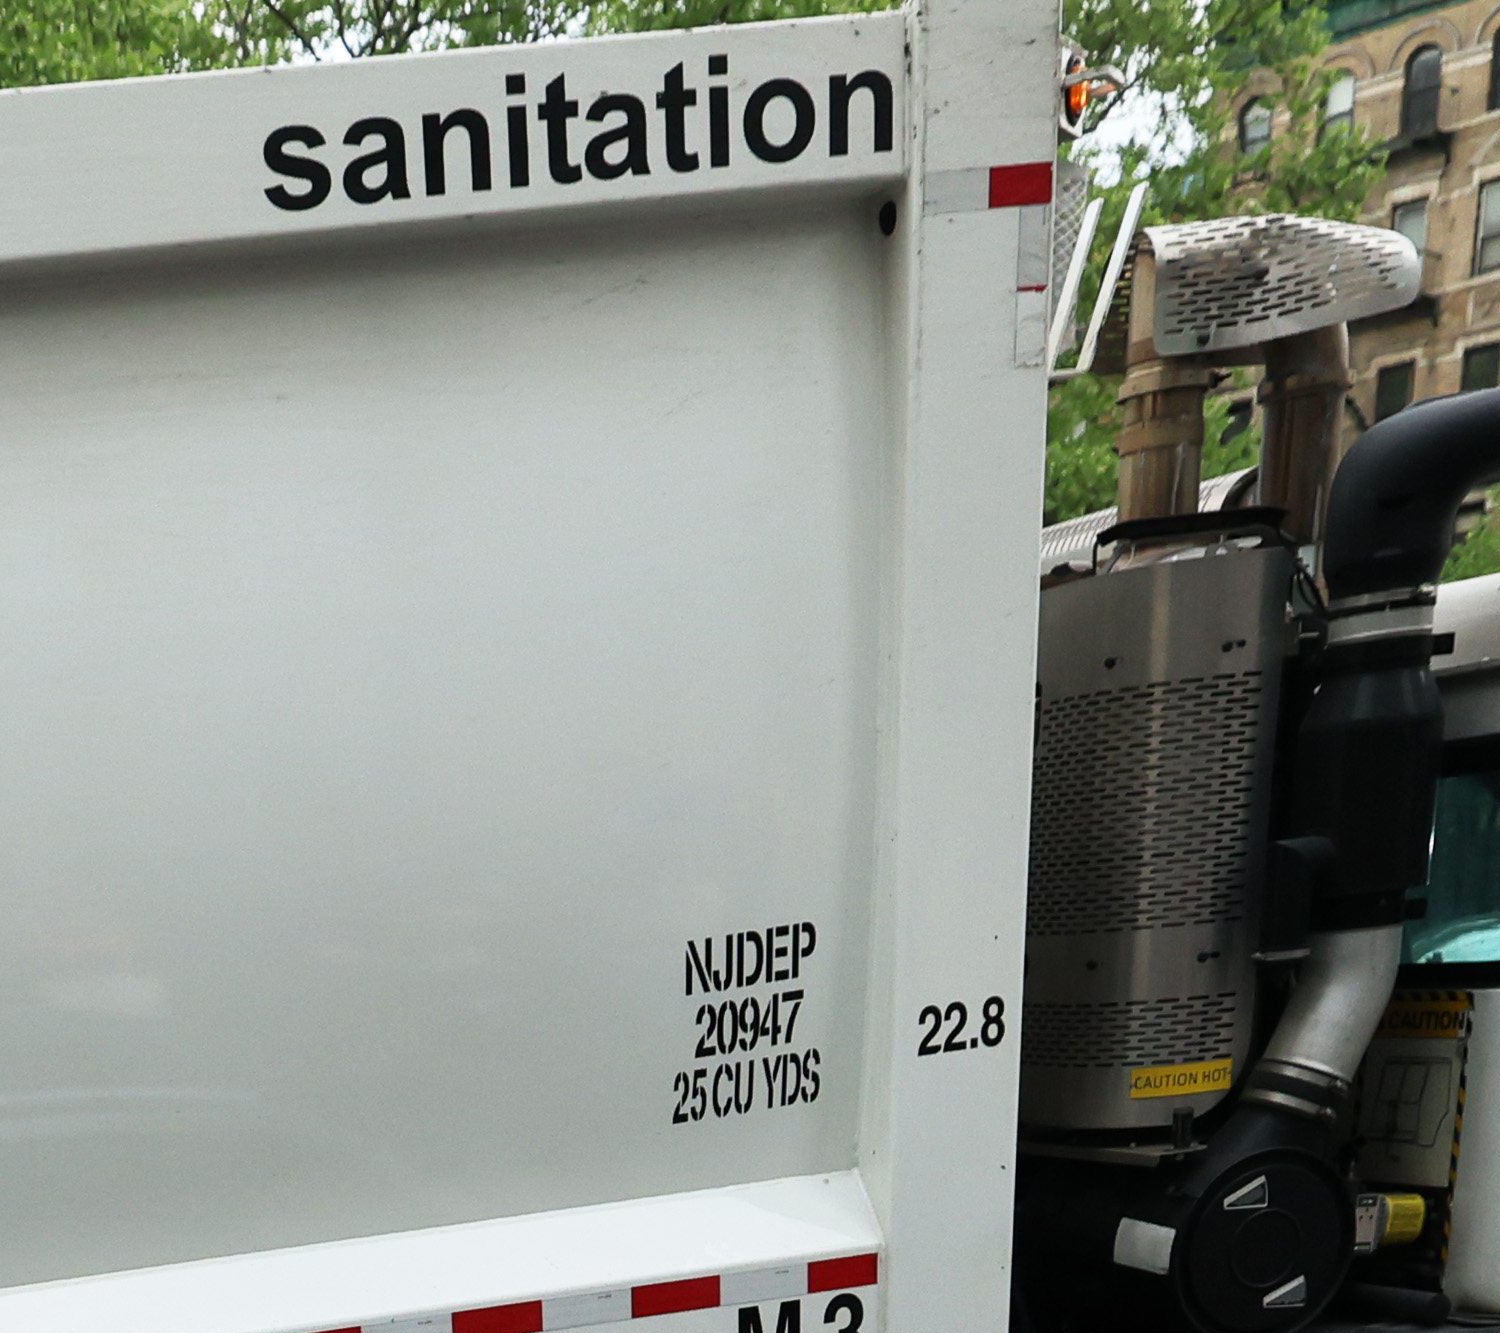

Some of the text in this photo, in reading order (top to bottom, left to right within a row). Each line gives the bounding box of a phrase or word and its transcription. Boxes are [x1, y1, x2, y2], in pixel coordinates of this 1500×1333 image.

[263, 53, 894, 212] sanitation
[685, 921, 817, 996] NJDEP
[692, 989, 806, 1060] 20947
[918, 996, 1005, 1056] 22.8
[671, 1048, 822, 1124] 25 CU YDS
[1134, 1067, 1229, 1091] CAUTION HOT
